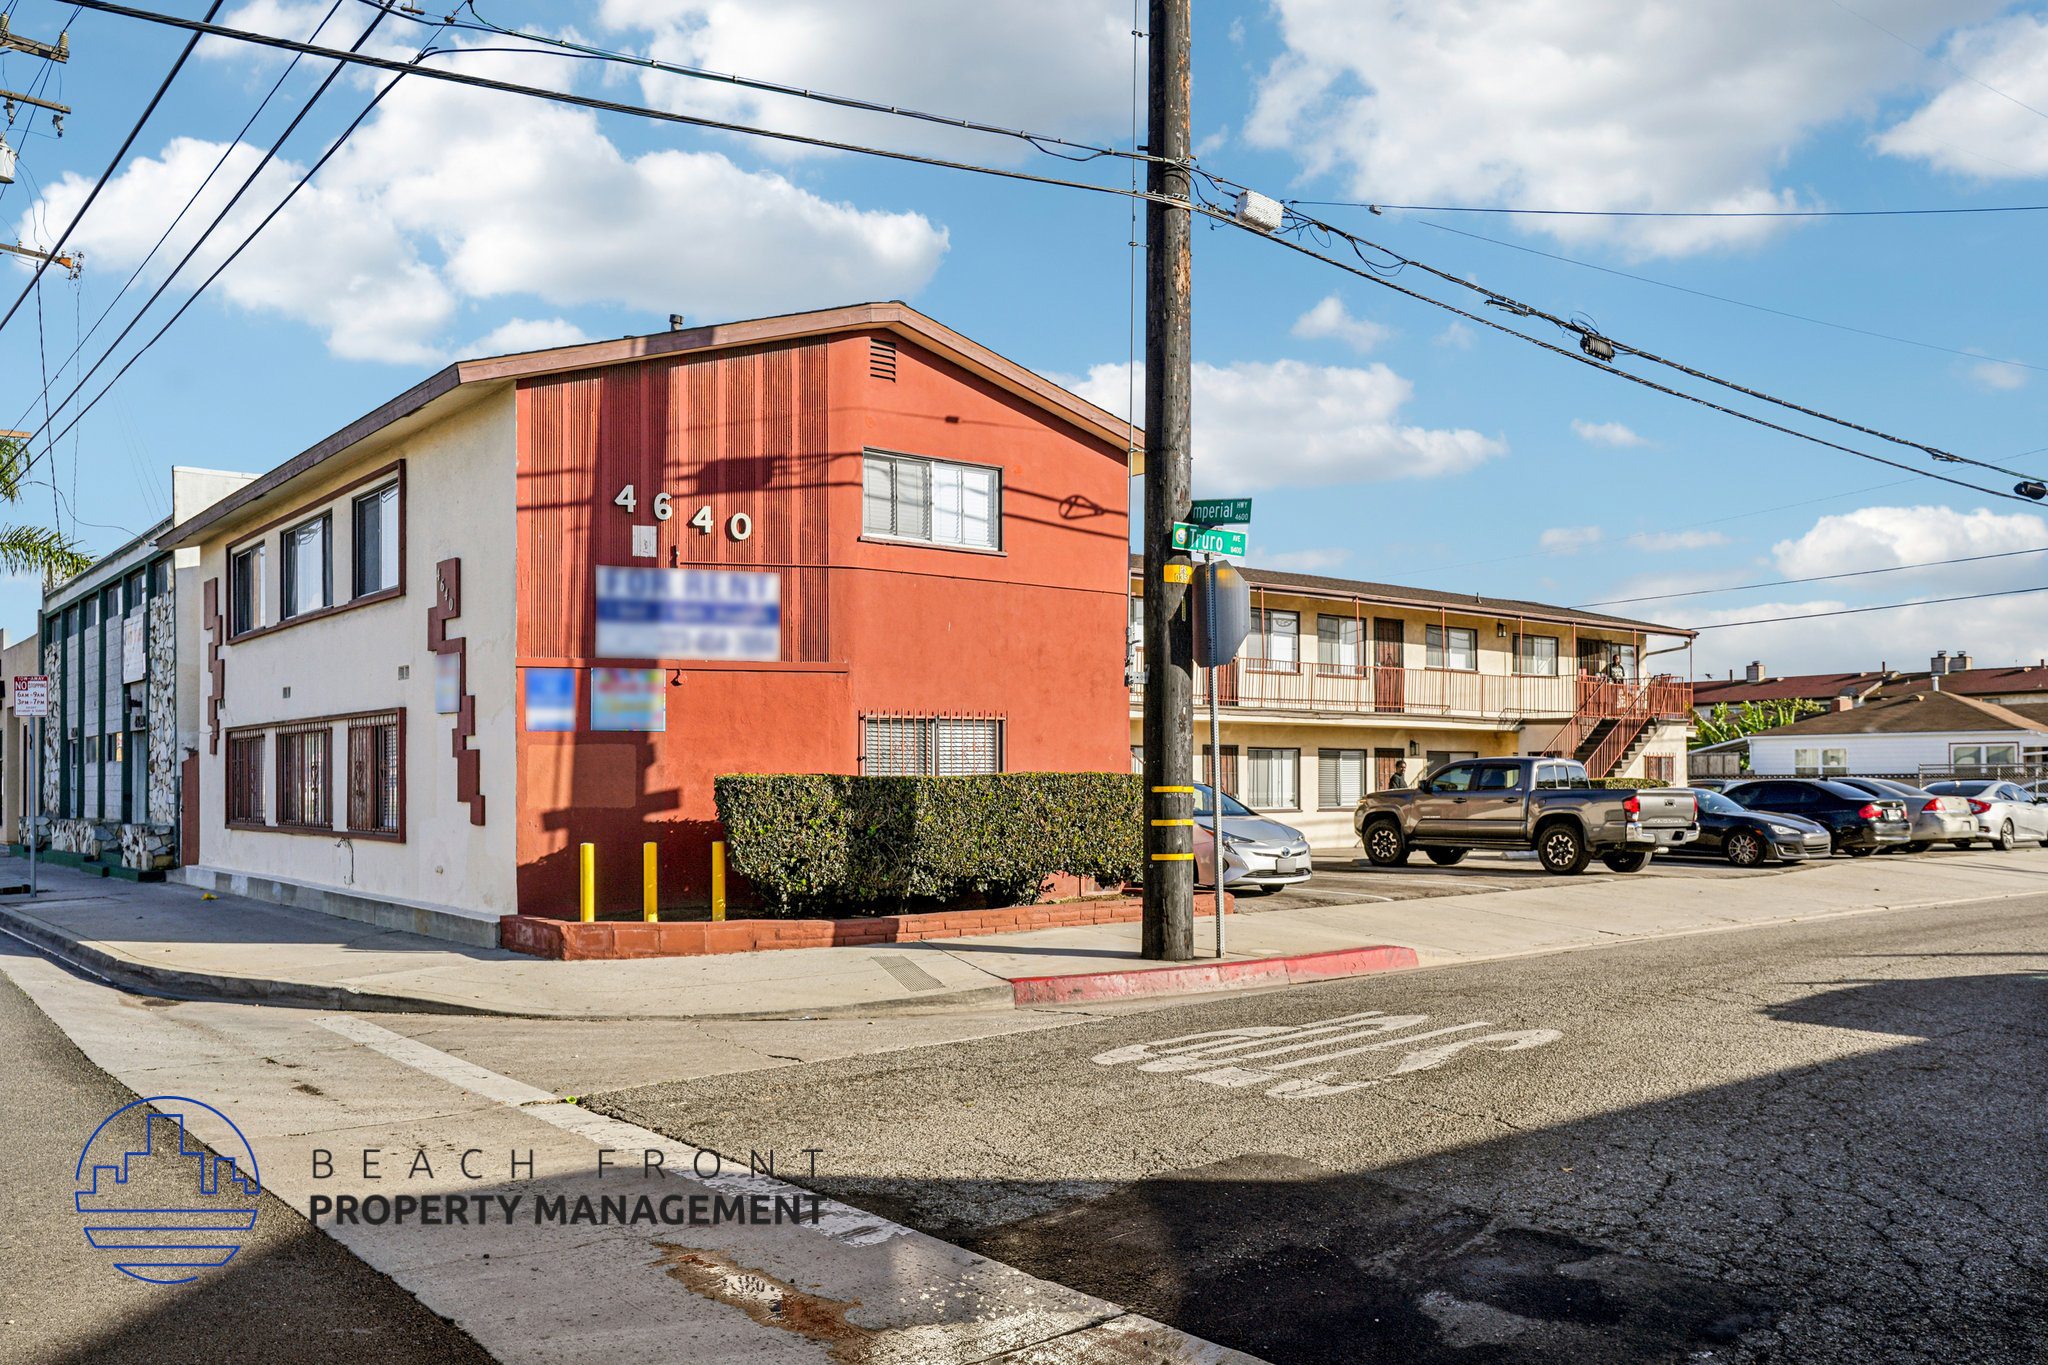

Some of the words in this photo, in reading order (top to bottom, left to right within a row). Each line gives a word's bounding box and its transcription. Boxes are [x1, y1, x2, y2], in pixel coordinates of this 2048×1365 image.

[1236, 501, 1248, 509] HWY
[614, 484, 752, 541] 4640
[1193, 502, 1233, 522] mperial
[1234, 513, 1249, 521] 4600
[1190, 528, 1223, 551] Truro
[1232, 535, 1241, 543] AVE
[15, 681, 27, 690] NO
